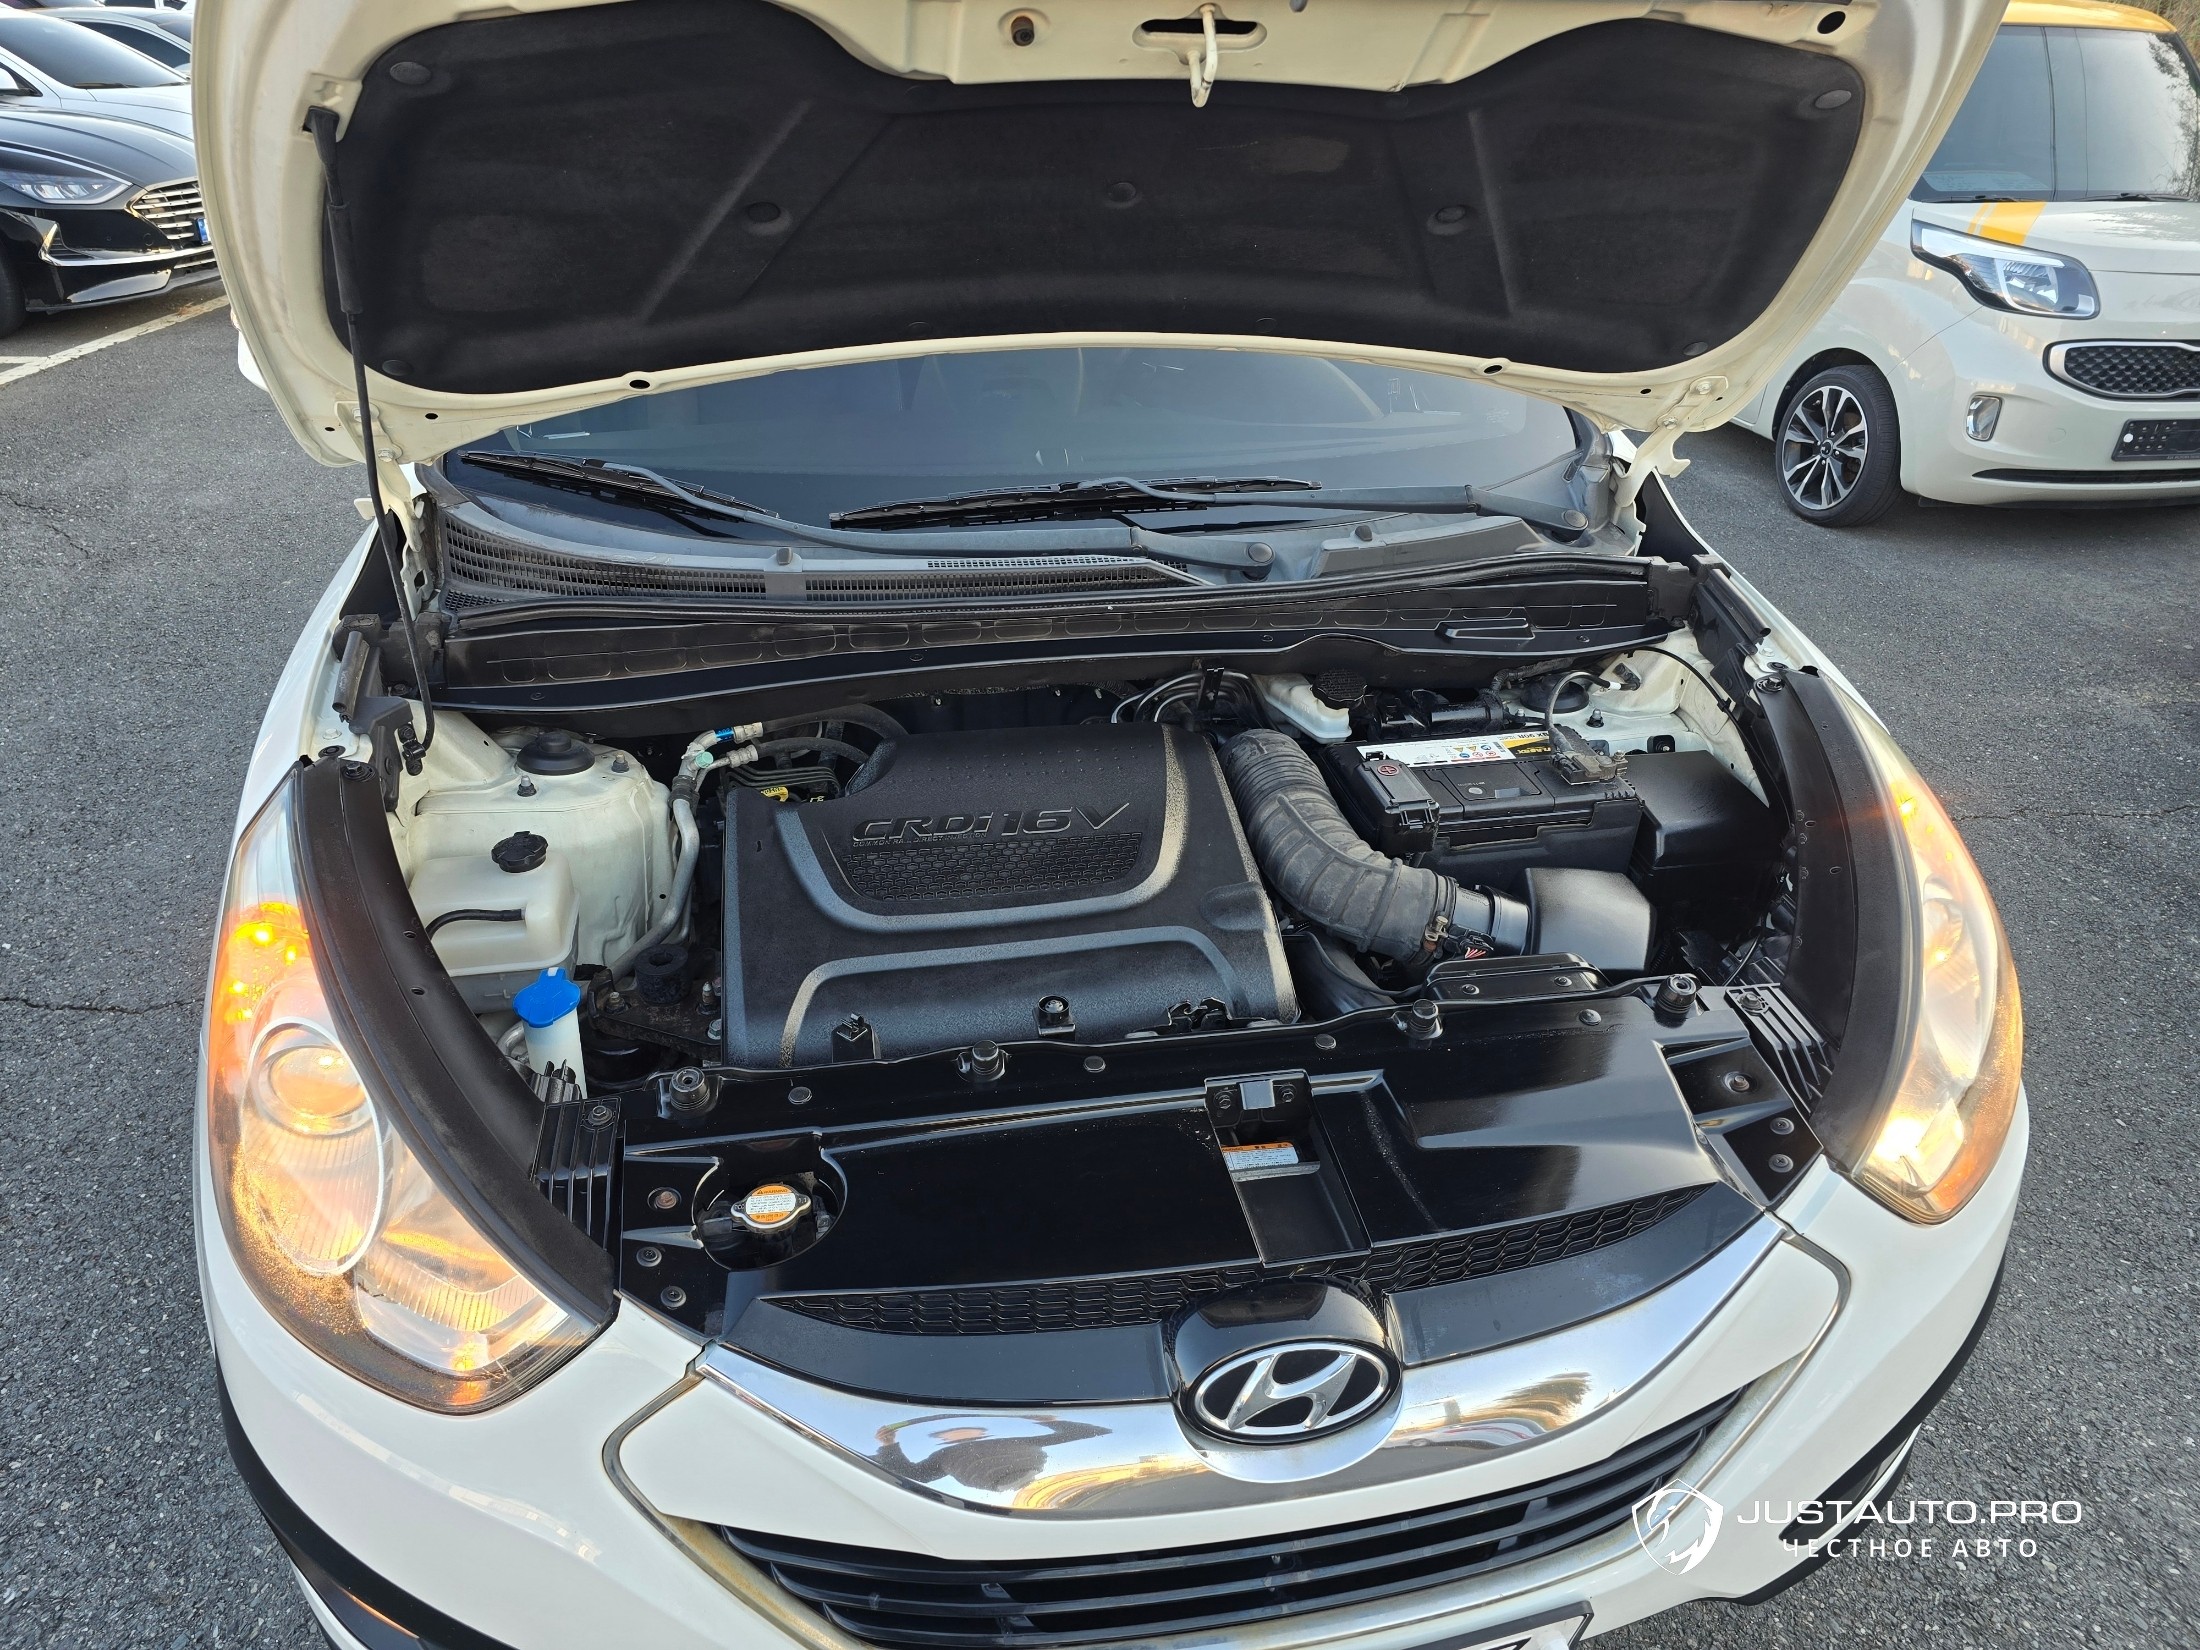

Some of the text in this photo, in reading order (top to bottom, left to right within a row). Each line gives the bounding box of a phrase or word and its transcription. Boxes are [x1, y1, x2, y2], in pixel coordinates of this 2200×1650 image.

[852, 802, 1130, 842] CRDi 16V
[852, 839, 891, 848] COMMON
